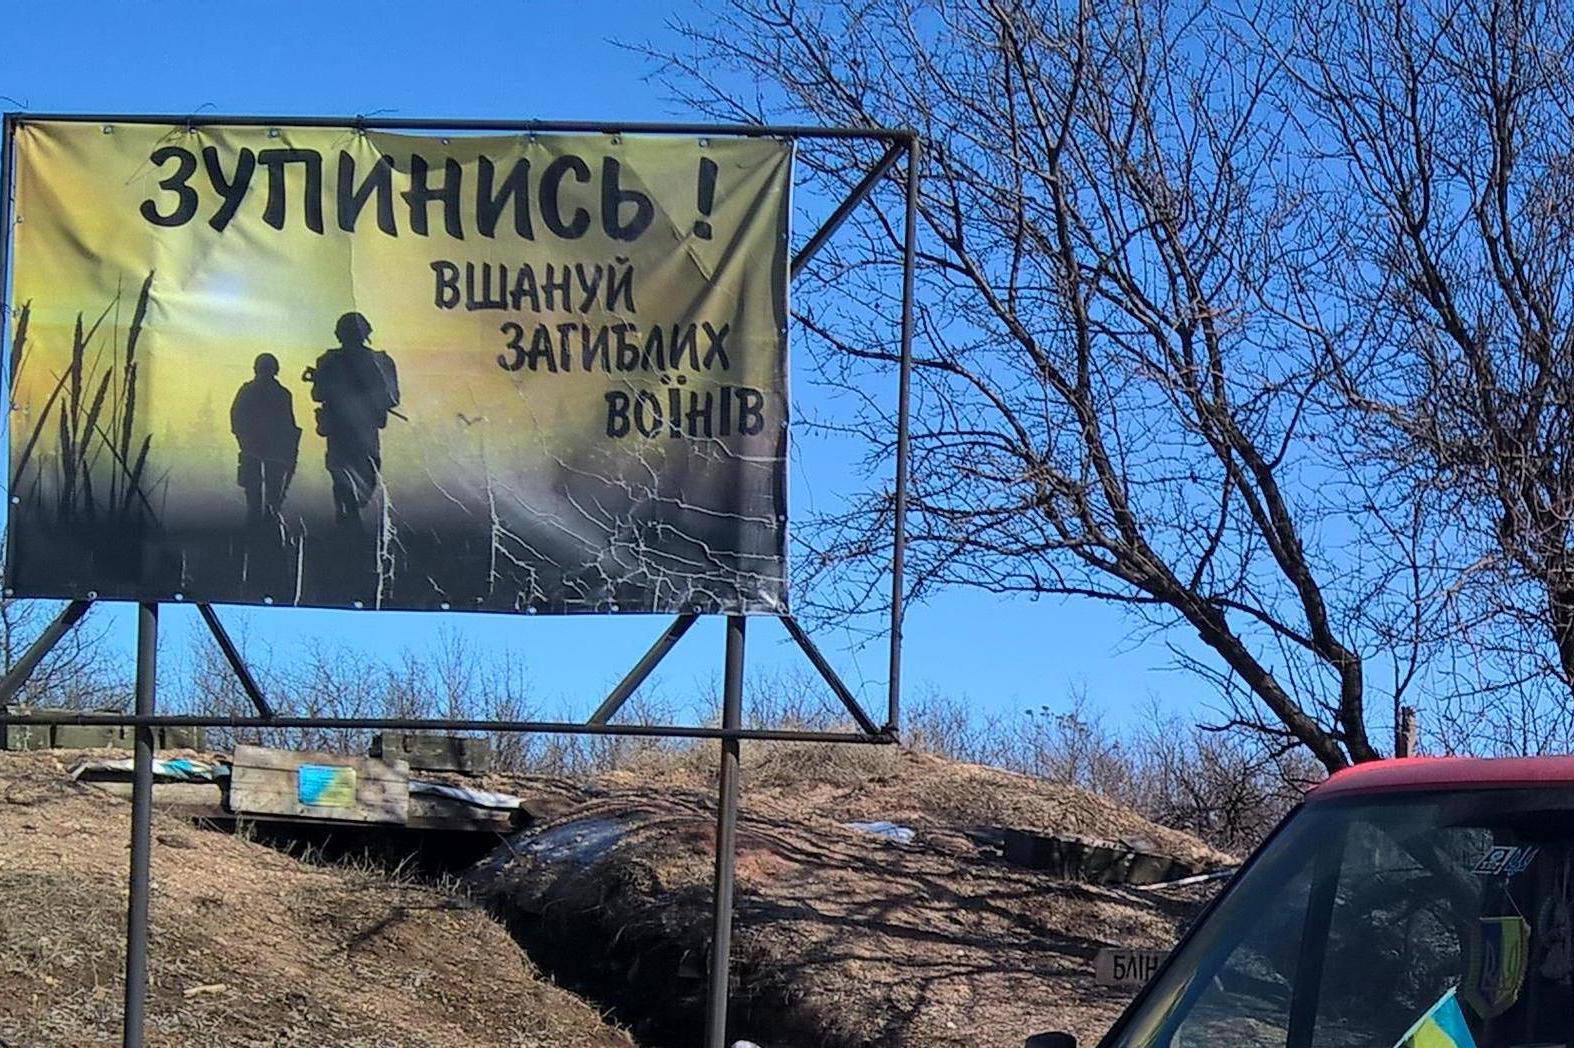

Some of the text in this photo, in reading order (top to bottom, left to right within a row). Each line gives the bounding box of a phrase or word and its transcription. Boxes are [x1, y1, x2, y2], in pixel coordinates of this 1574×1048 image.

[139, 145, 655, 241] ЗУПИНИСЬ
[430, 256, 637, 314] ВШАНУЙ
[499, 320, 731, 374] ЗАГИБЛИХ
[604, 374, 766, 439] ВОЇНІВ
